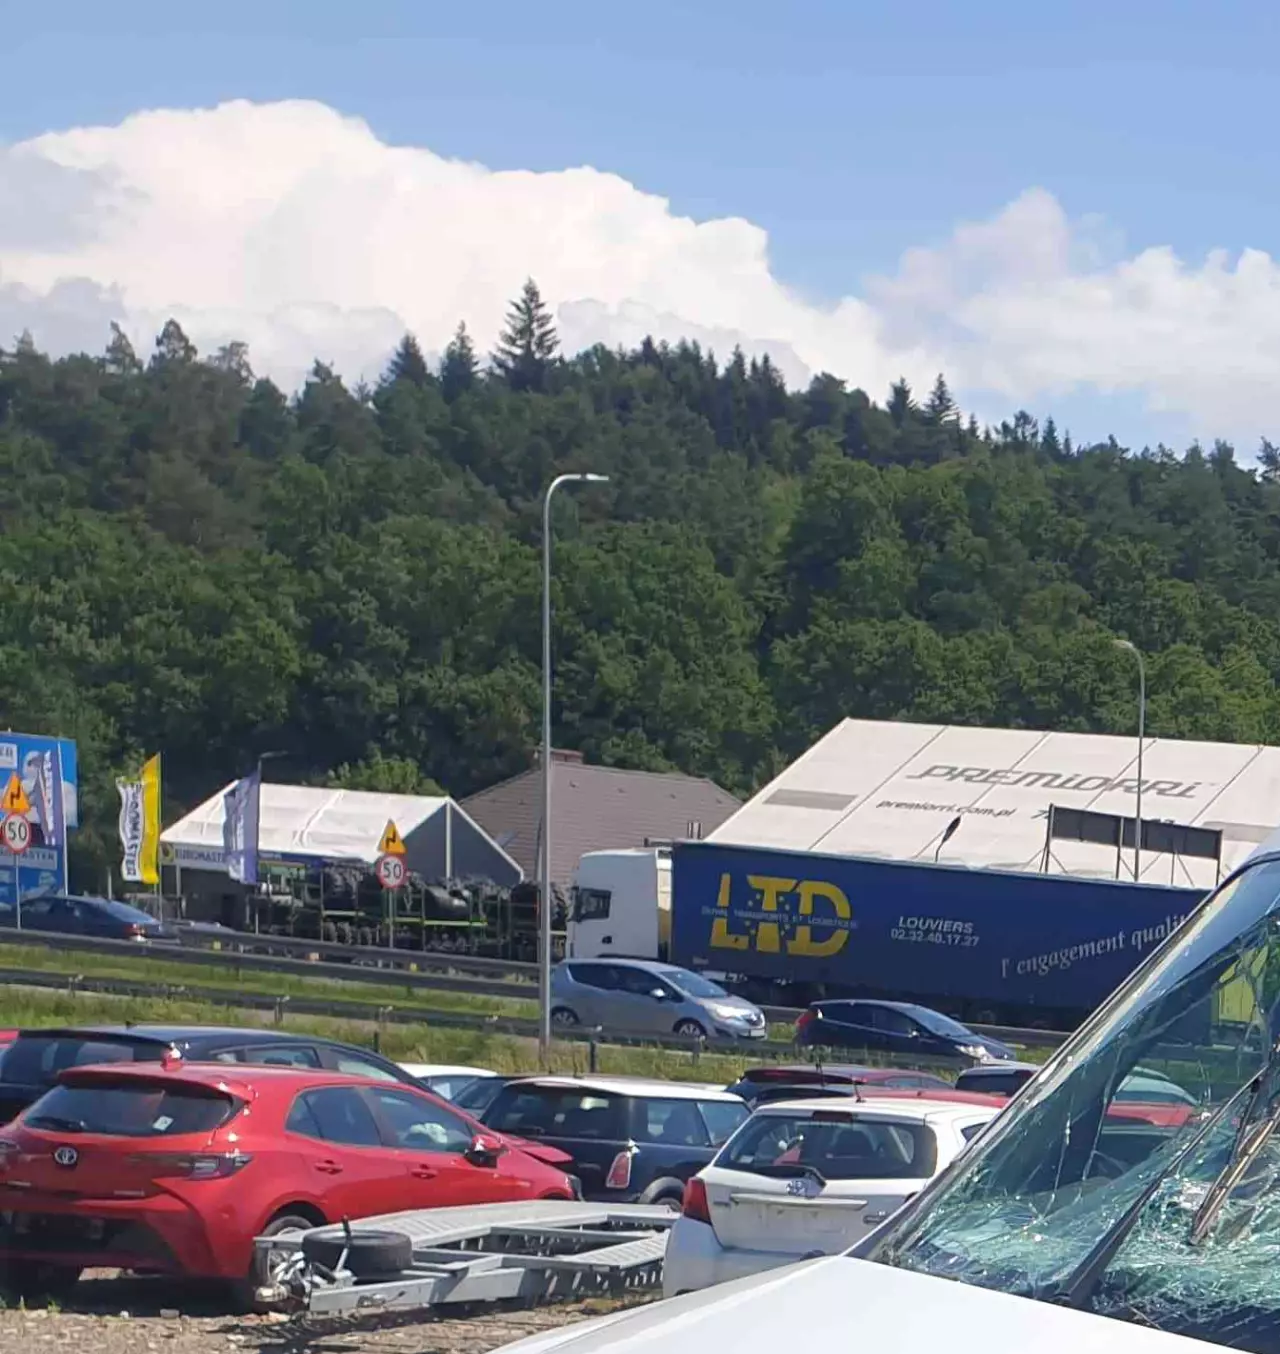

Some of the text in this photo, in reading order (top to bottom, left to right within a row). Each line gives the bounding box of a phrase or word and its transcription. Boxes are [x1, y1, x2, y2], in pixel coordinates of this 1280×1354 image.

[8, 822, 28, 842] 50
[383, 861, 402, 878] 50
[709, 872, 852, 957] LTD
[898, 916, 974, 934] LOUVIERS
[1131, 914, 1186, 952] quali
